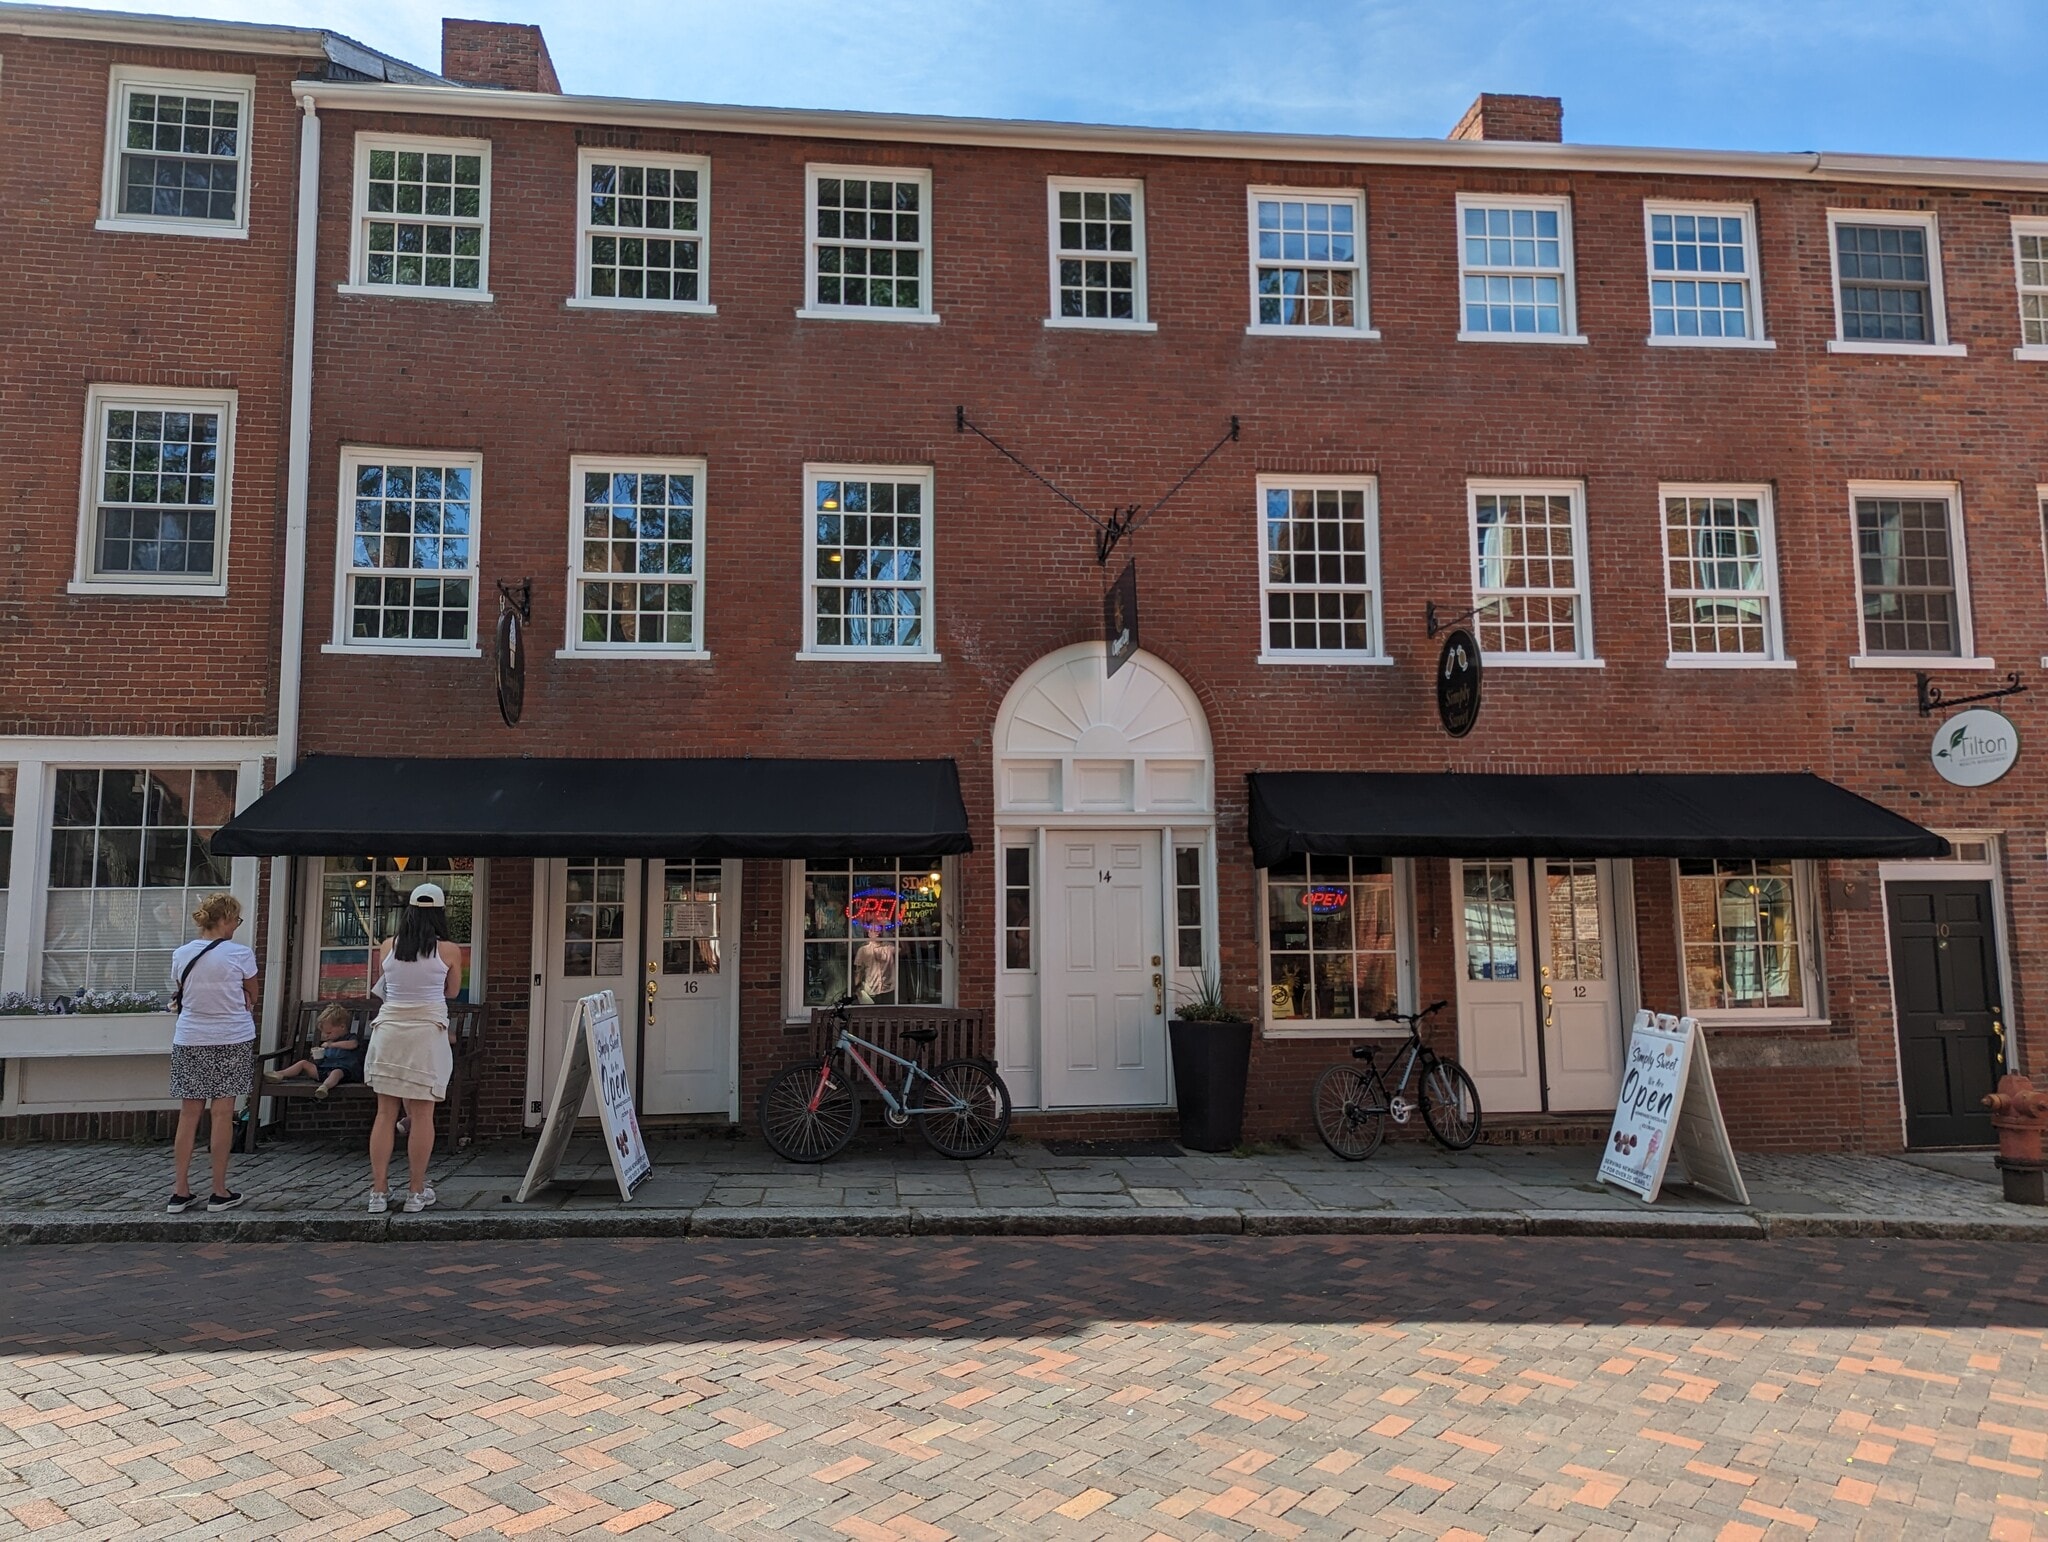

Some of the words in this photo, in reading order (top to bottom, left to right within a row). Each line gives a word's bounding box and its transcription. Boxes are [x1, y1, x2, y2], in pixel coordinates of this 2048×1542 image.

[1962, 736, 2007, 757] Tilton
[1099, 870, 1112, 883] 14
[1302, 893, 1348, 906] OPEN
[845, 898, 907, 920] OPEN
[1936, 923, 1950, 938] 10
[684, 981, 698, 993] 16
[1573, 986, 1587, 998] 12
[1632, 1046, 1655, 1072] Simply
[1656, 1052, 1679, 1071] Sweet
[602, 1063, 630, 1119] Open
[1622, 1067, 1673, 1121] Open
